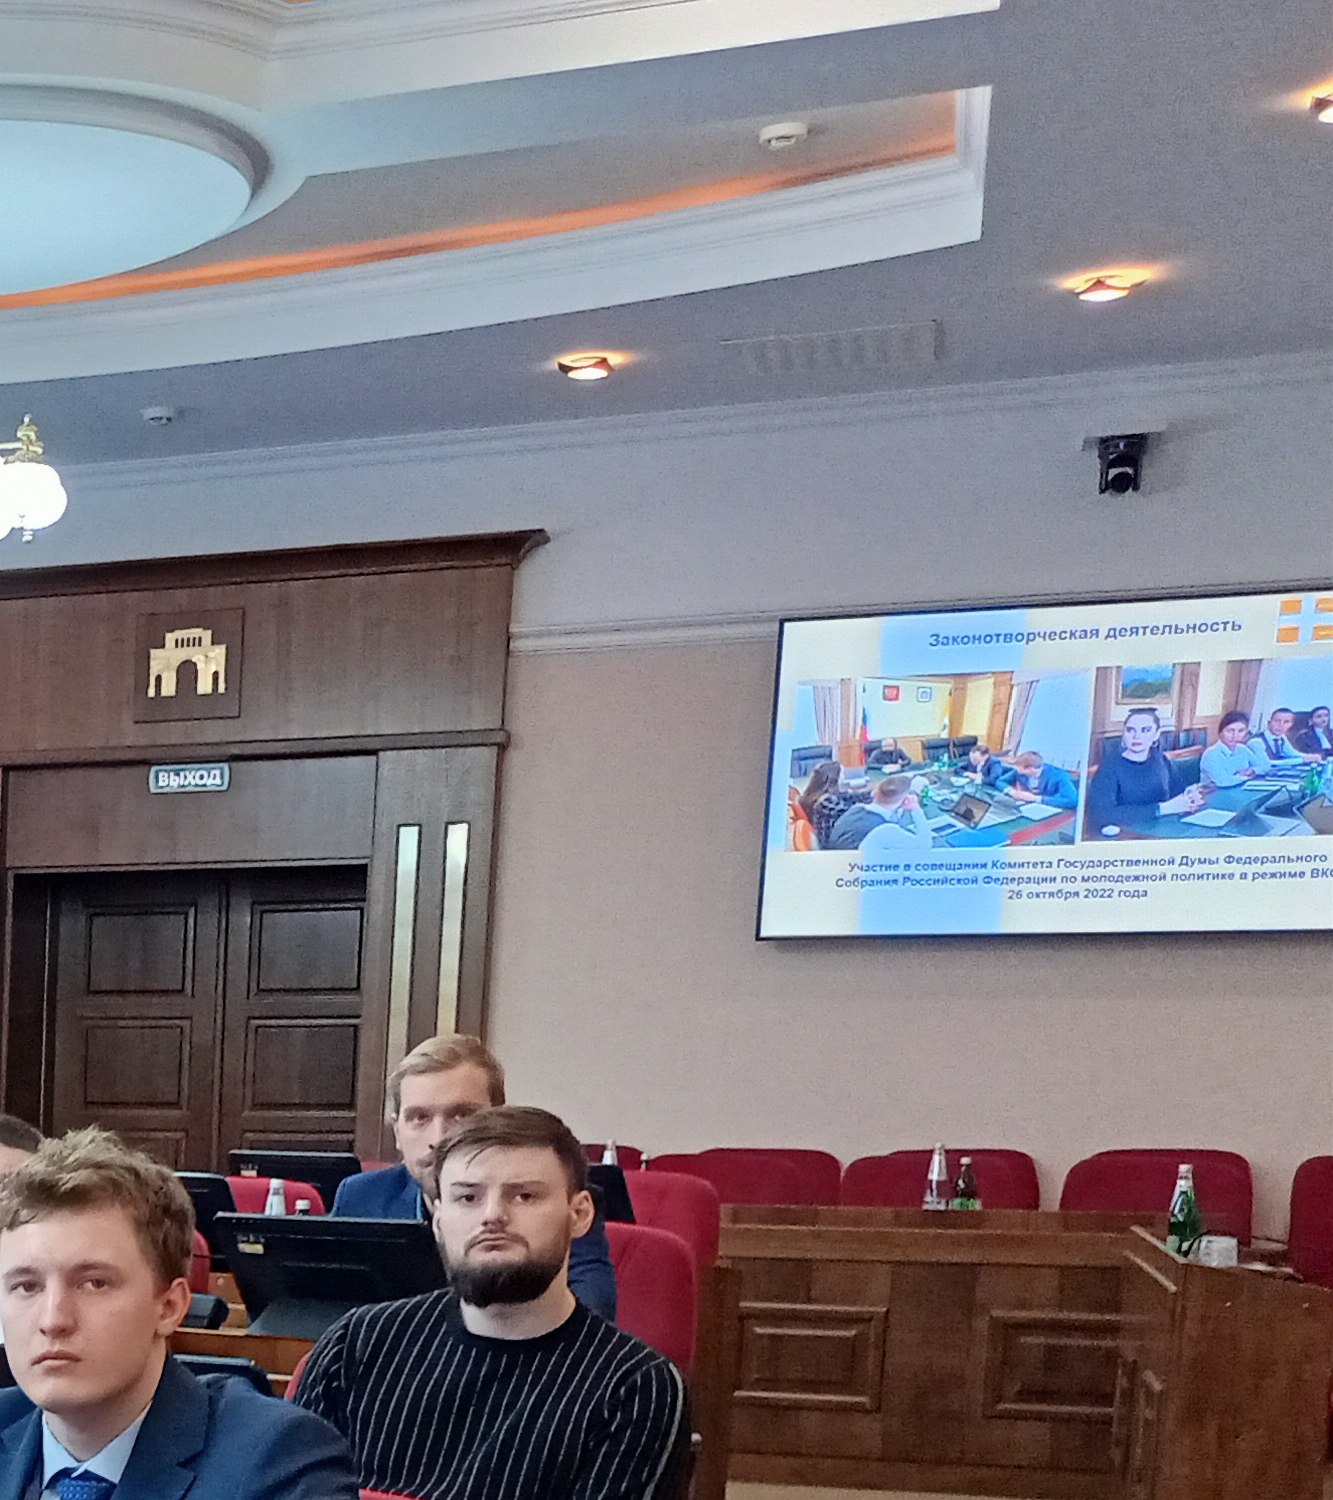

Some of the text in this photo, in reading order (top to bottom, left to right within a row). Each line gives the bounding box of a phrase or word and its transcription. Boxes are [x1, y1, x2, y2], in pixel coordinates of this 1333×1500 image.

[928, 620, 1243, 647] Законотворческая деятельность
[158, 770, 223, 787] ВЫХОД
[848, 862, 900, 873] Участие
[914, 861, 988, 873] совещании
[991, 859, 1053, 870] Комитета
[1057, 857, 1175, 870] Государственной
[1178, 855, 1220, 868] Думы
[1223, 853, 1328, 866] Федерального
[835, 876, 899, 889] Собрания
[902, 875, 979, 888] Российской
[982, 874, 1058, 886] Федерации
[1061, 875, 1077, 884] по
[1081, 871, 1167, 884] молодежной
[1171, 871, 1235, 882] политике
[1251, 870, 1305, 882] режиме
[1007, 888, 1148, 901] 26 октября 2022 года
